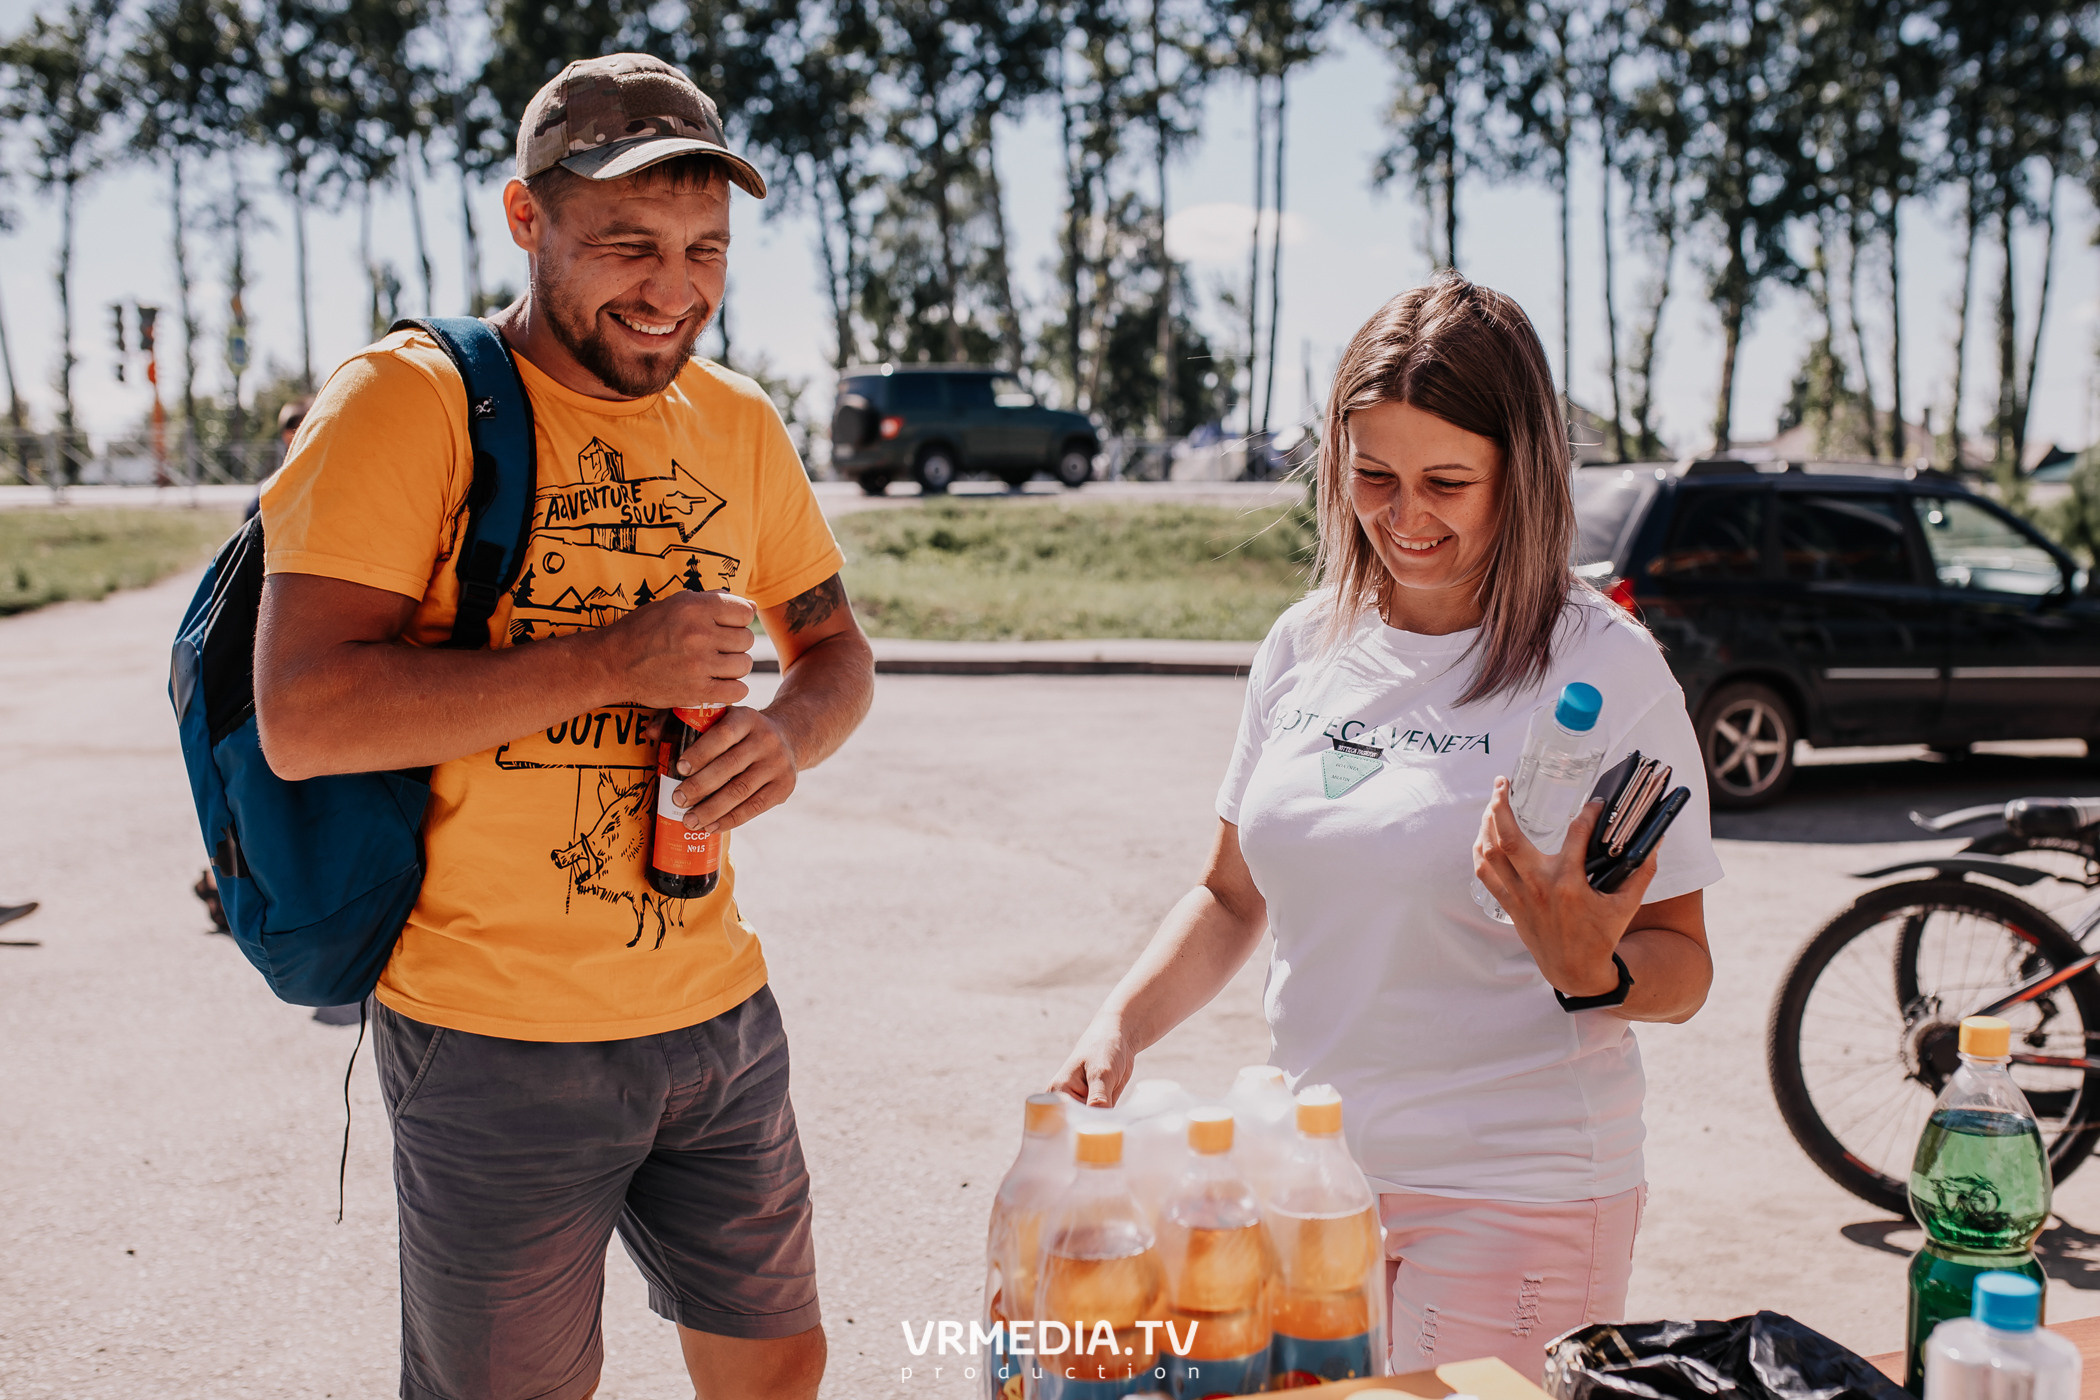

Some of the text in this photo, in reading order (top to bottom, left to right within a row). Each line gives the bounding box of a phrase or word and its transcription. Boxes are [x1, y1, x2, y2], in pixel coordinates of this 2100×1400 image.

[620, 503, 673, 524] SOUL
[546, 709, 656, 749] OUTVE
[1273, 708, 1490, 755] BOTEG VENETA
